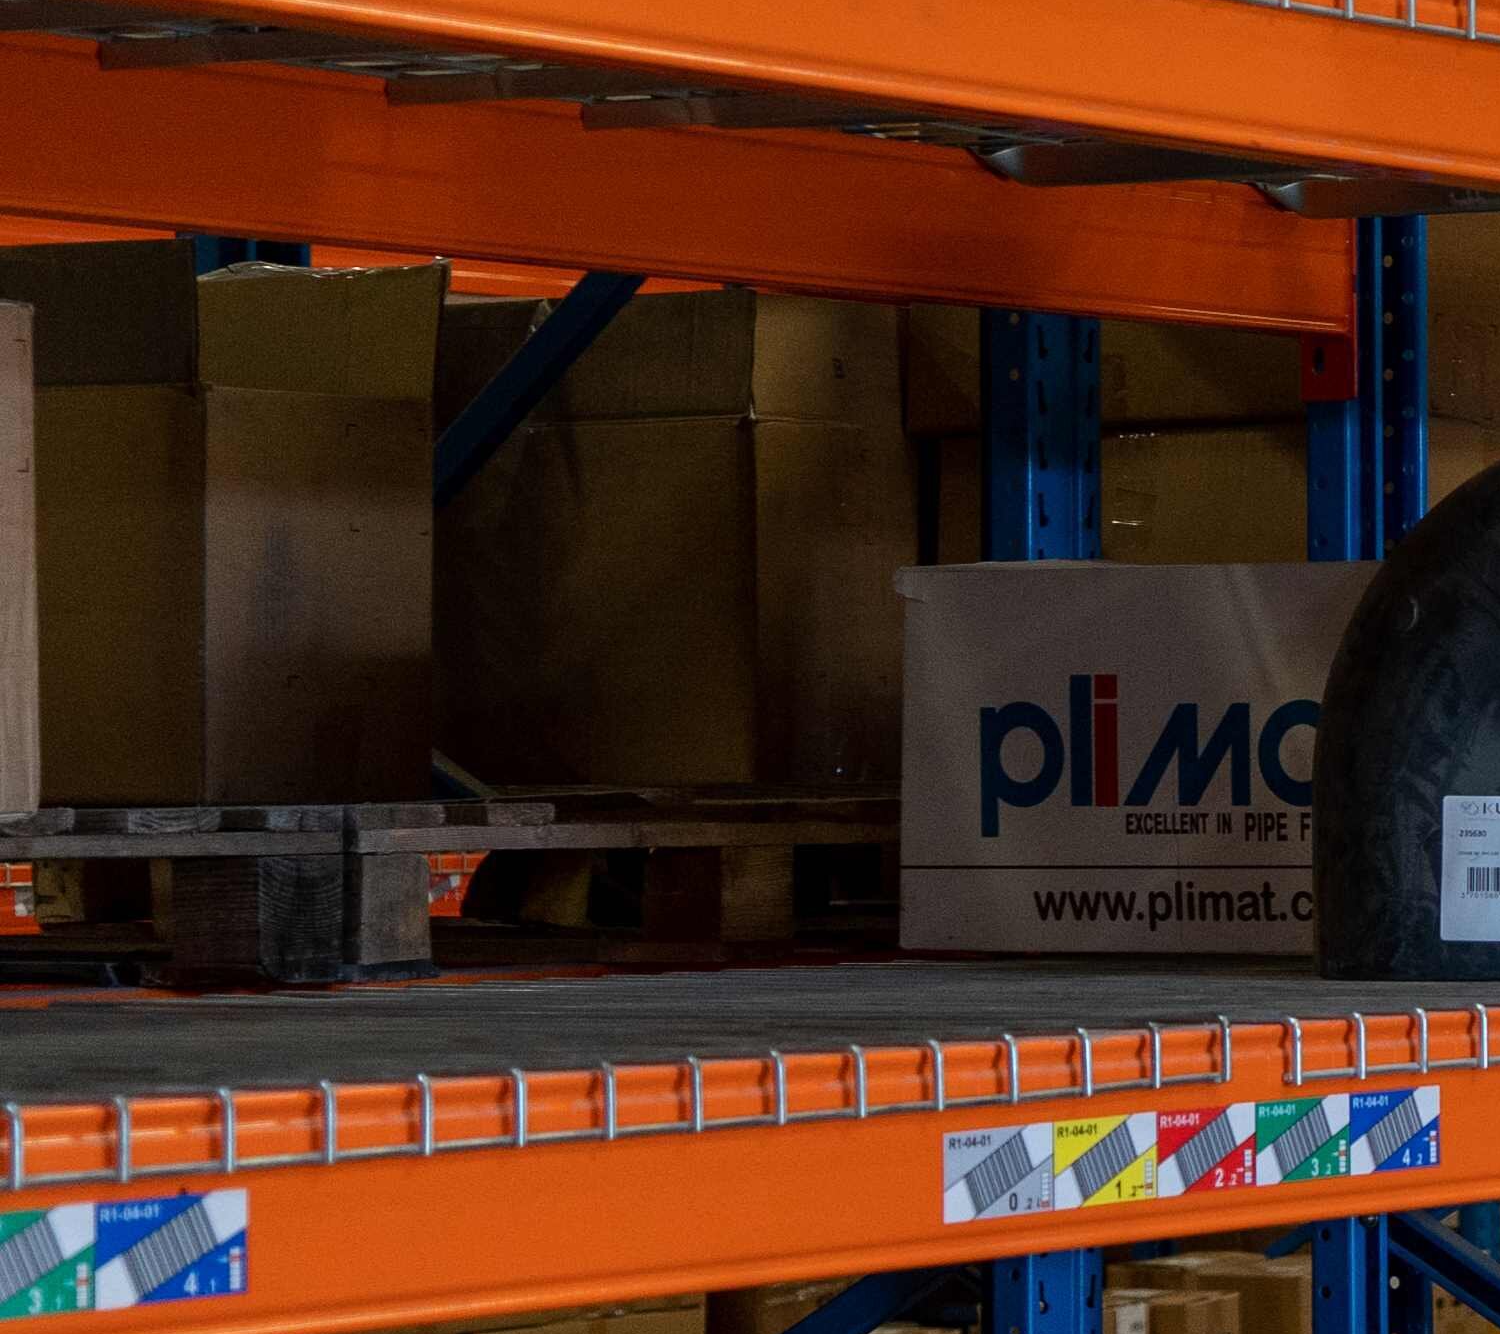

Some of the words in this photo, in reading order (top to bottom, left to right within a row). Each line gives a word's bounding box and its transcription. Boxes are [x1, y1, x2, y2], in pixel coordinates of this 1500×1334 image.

[1126, 813, 1209, 835] EXCELLENT
[1217, 813, 1232, 835] IN
[1245, 813, 1288, 842] PIPE
[1351, 1095, 1390, 1110] R1-04-01
[1258, 1105, 1297, 1119] R1-04-01
[1160, 1114, 1200, 1129] R1-04-01
[1056, 1124, 1098, 1140] R1-04-01
[948, 1135, 992, 1151] R1-04-01
[1402, 1148, 1411, 1166] 4
[1311, 1158, 1320, 1176] 3
[1215, 1169, 1224, 1187] 2
[1115, 1181, 1122, 1199] 1
[1008, 1193, 1018, 1211] 0
[183, 1271, 198, 1295] 4
[28, 1286, 43, 1315] 3
